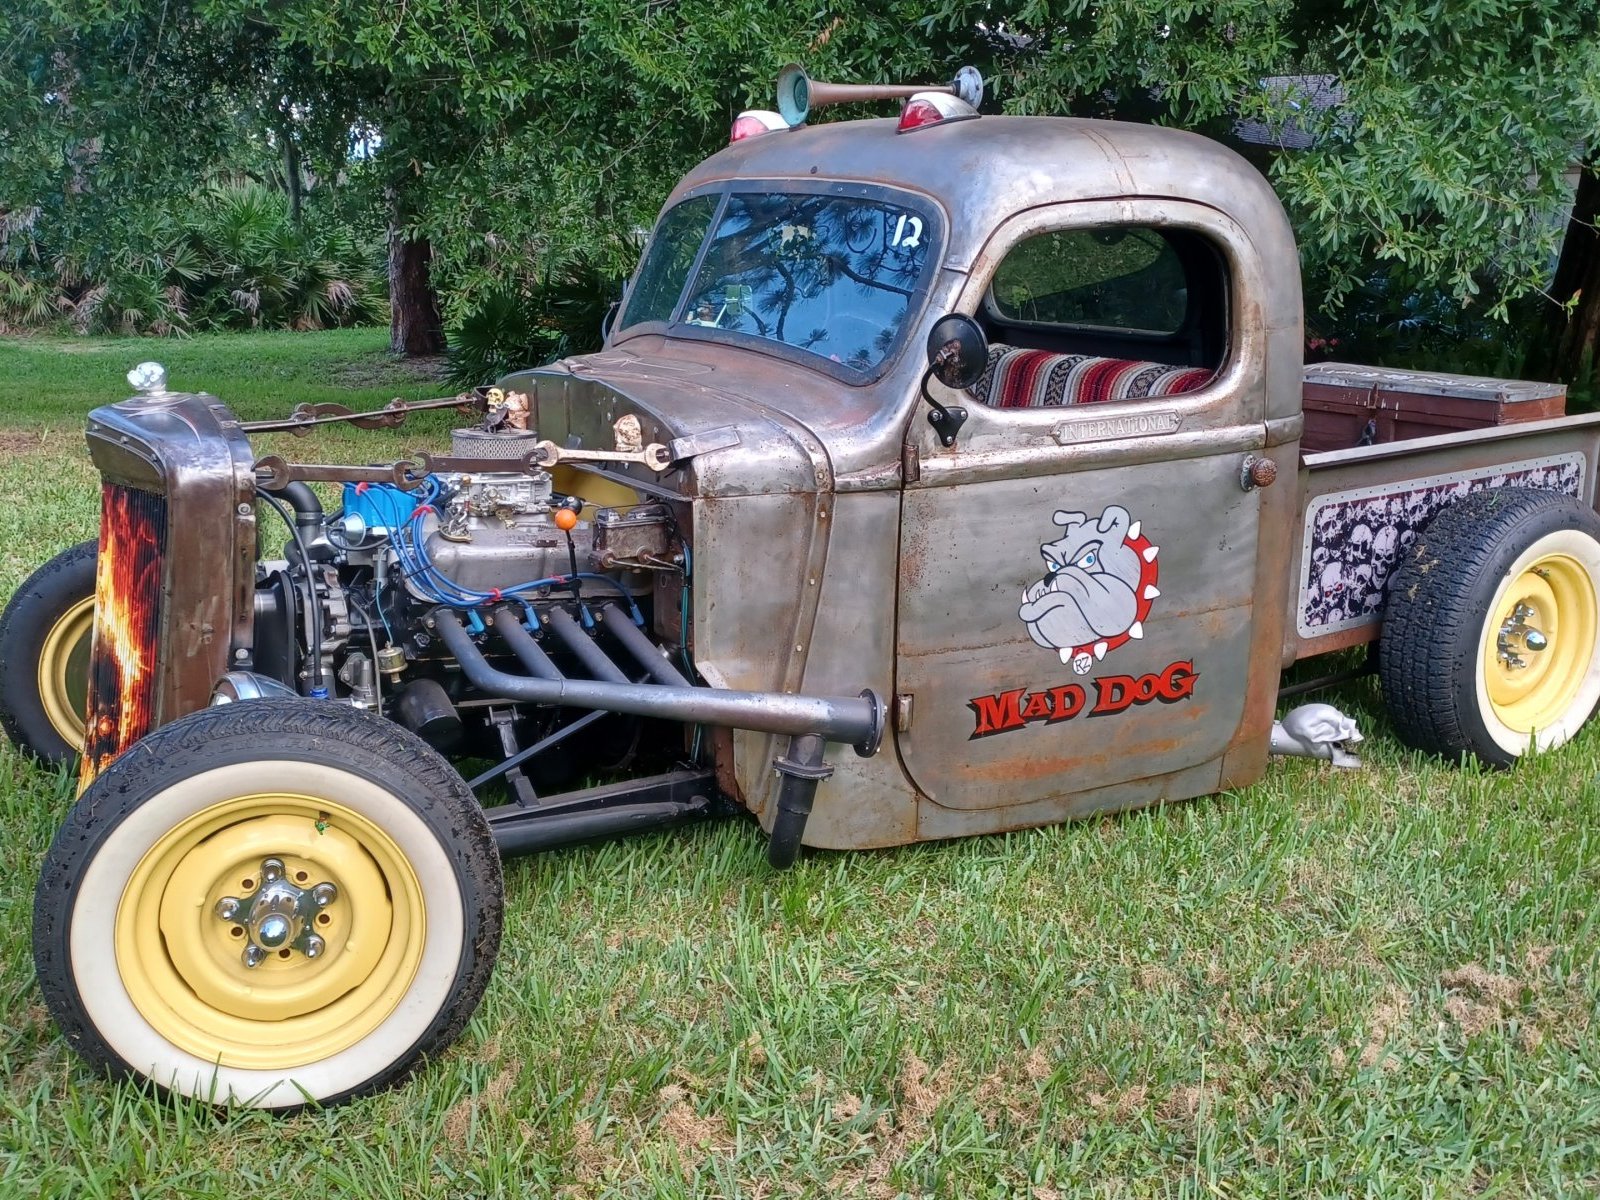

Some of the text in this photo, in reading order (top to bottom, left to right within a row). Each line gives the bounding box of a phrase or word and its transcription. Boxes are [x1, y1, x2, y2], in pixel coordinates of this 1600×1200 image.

[892, 214, 920, 248] 12
[1063, 414, 1174, 440] INTERNATIONAL
[1074, 656, 1091, 673] RZ
[967, 658, 1200, 741] MAD DOG
